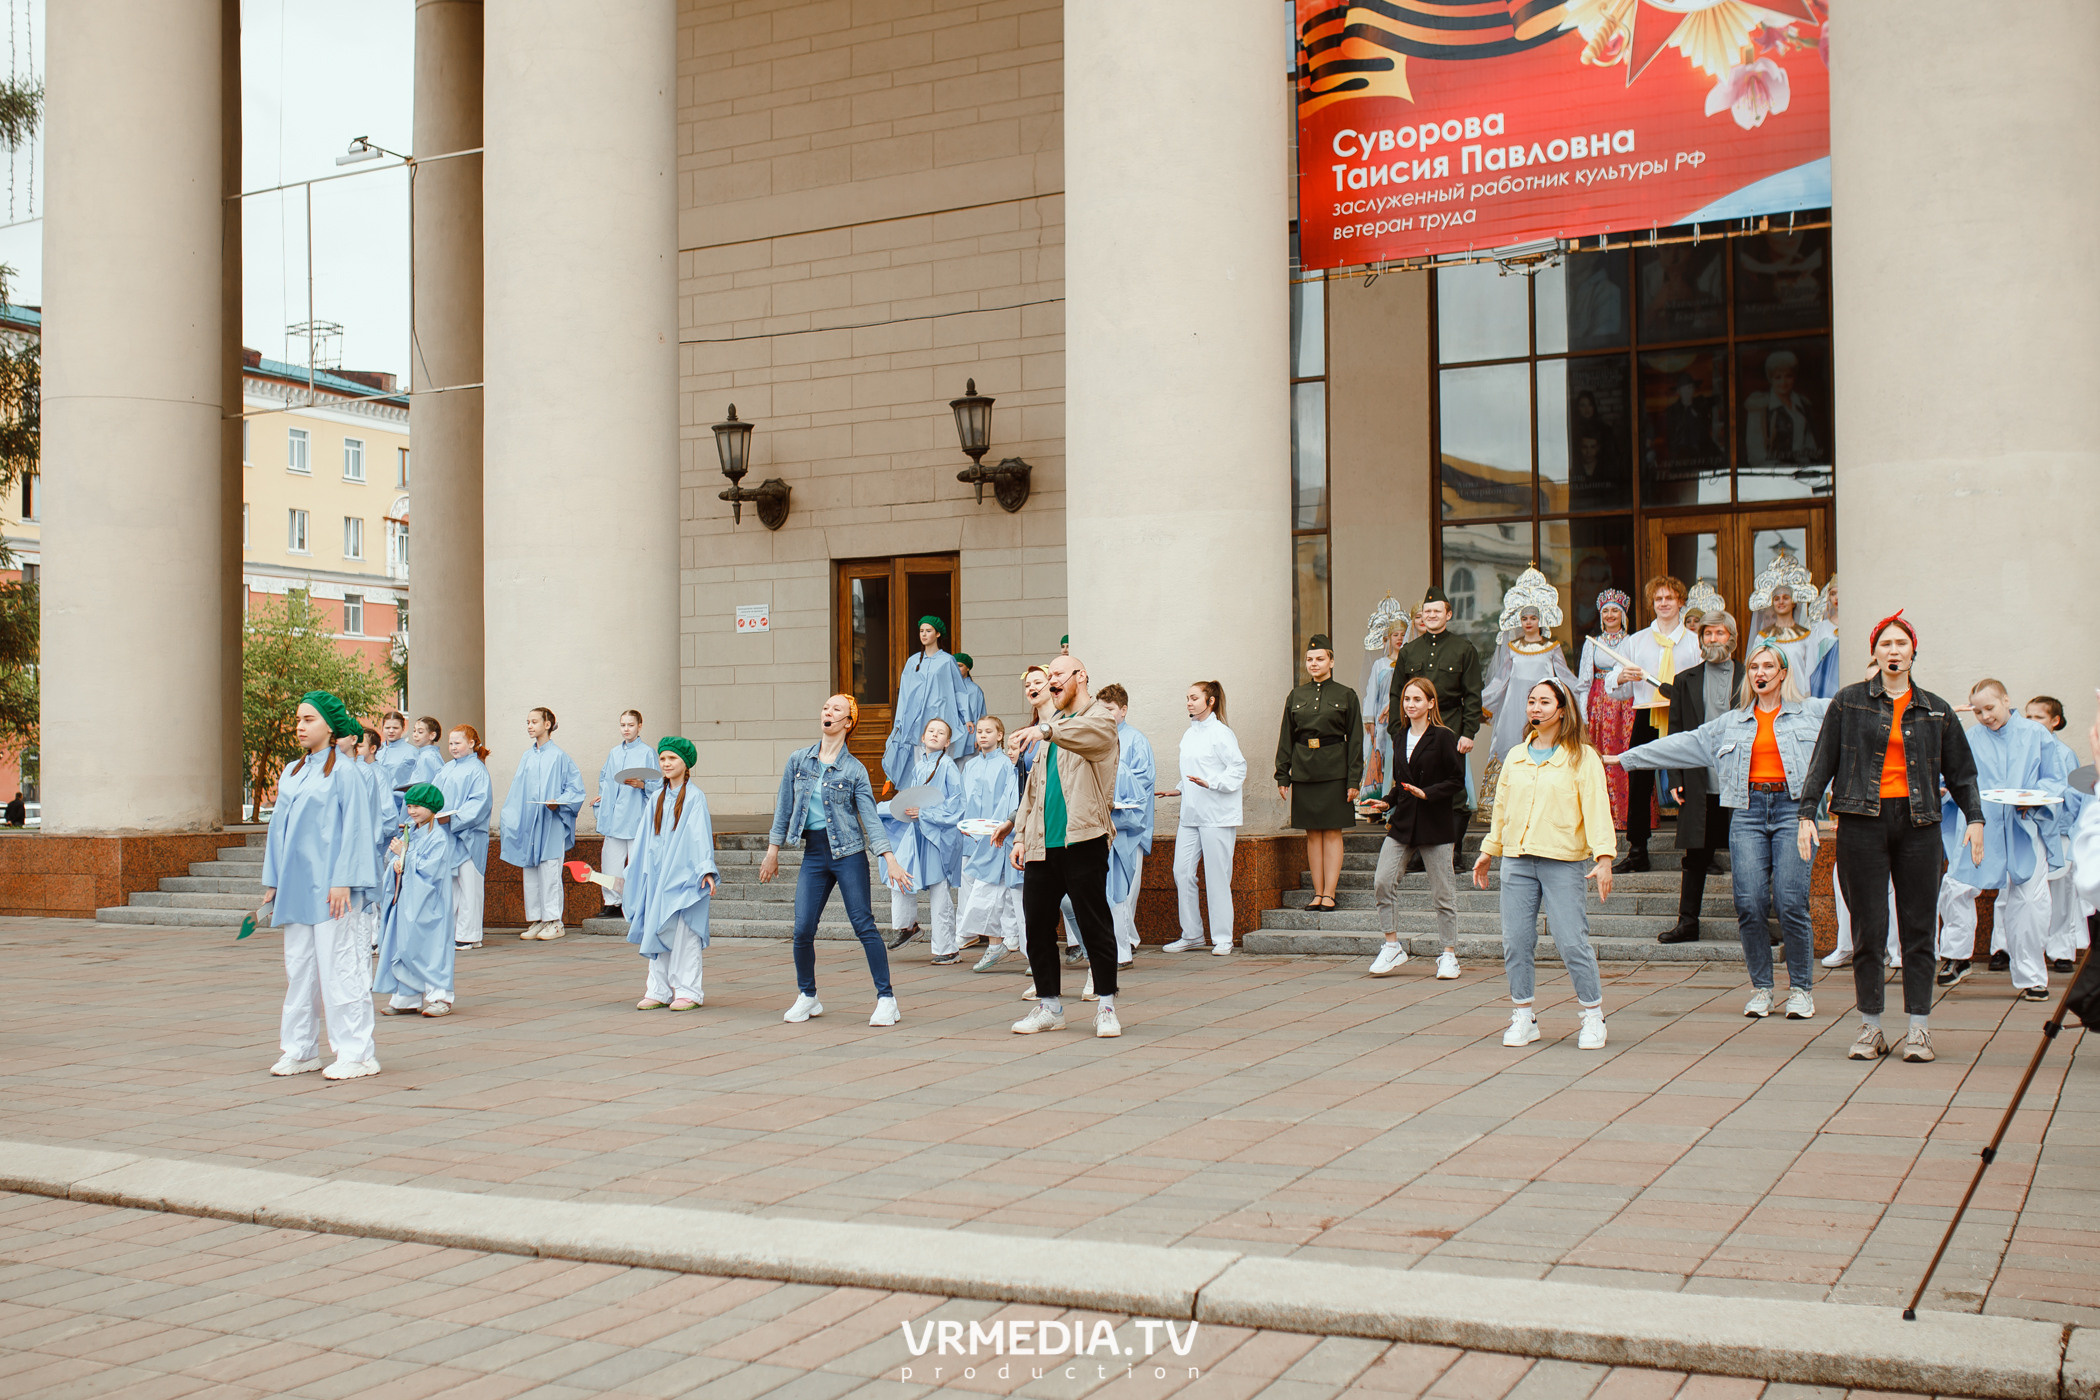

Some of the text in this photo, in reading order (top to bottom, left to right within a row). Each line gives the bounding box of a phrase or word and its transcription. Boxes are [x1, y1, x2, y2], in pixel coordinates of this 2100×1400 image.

[1331, 128, 1635, 192] Таисия Павловна
[1332, 113, 1505, 161] Суворова
[1332, 150, 1706, 217] заслуженный работник культуры РФ
[1332, 208, 1477, 241] ветеран труда
